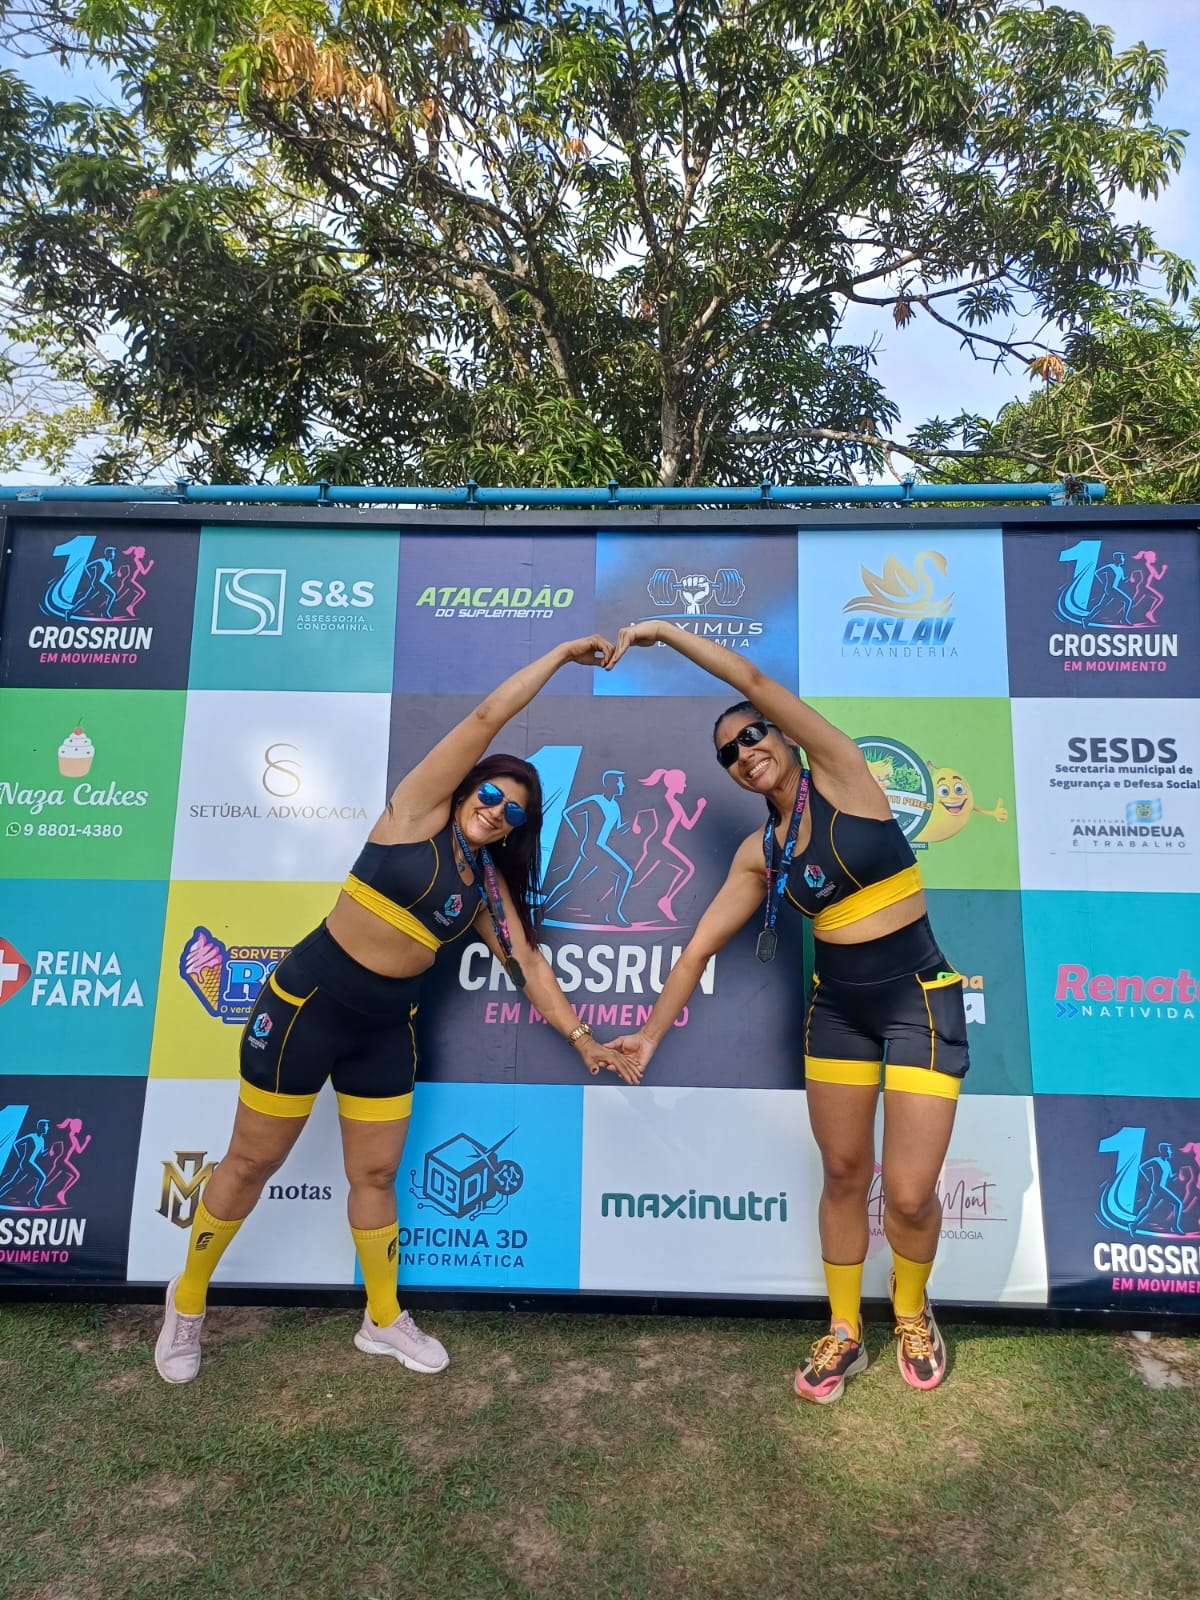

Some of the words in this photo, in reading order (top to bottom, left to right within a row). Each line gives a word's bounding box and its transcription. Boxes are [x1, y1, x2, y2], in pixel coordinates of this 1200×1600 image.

[299, 579, 375, 608] S&S
[415, 585, 575, 608] ATACADÃO
[297, 615, 366, 623] ASSESSORIA
[434, 608, 455, 618] DO
[296, 623, 375, 632] CONDOMINIAL
[630, 622, 764, 635] XIMUS
[842, 617, 956, 646] CISLAV
[28, 625, 153, 650] CROSSRUN
[1049, 633, 1178, 657] CROSSRUN
[39, 652, 58, 663] EM
[60, 652, 138, 664] MOVIMENTO
[841, 647, 959, 658] LAVANDERIA
[1064, 661, 1082, 671] EM
[1085, 661, 1167, 672] MOVIMENTO
[1067, 737, 1178, 764] SESDS
[1055, 764, 1115, 774] Secretaria
[1118, 765, 1176, 776] municipal
[1178, 765, 1193, 775] de
[1049, 779, 1111, 790] Segurança
[1123, 780, 1164, 789] Defesa
[1166, 780, 1200, 789] Social
[0, 782, 66, 815] Naza
[73, 781, 149, 806] Cakes
[189, 802, 262, 819] SETÚBAL
[266, 805, 368, 820] ADVOCACIA
[23, 823, 34, 836] 9
[37, 823, 123, 837] 8801-4380
[1072, 825, 1185, 837] ANANINDEUA
[1093, 839, 1186, 848] TRABALHO
[230, 948, 293, 960] SORVET
[35, 951, 122, 976] REINA
[459, 942, 717, 995] CRSSRU
[1055, 963, 1200, 1003] Renat
[31, 978, 144, 1007] FARMA
[230, 1005, 252, 1014] verd
[484, 1002, 521, 1025] EM
[528, 1003, 689, 1027] MVIMEN
[1081, 1005, 1195, 1019] NATIVIDA
[269, 1183, 332, 1200] notas
[0, 1217, 87, 1246] SSRUN
[398, 1226, 490, 1248] OFICINA
[495, 1229, 528, 1249] 3D
[941, 1230, 984, 1240] DOLOGIA
[398, 1251, 525, 1268] INFORMÁTICA
[1093, 1242, 1200, 1275] CROSSR
[1112, 1277, 1134, 1291] EM
[1137, 1278, 1200, 1294] MOVIME
